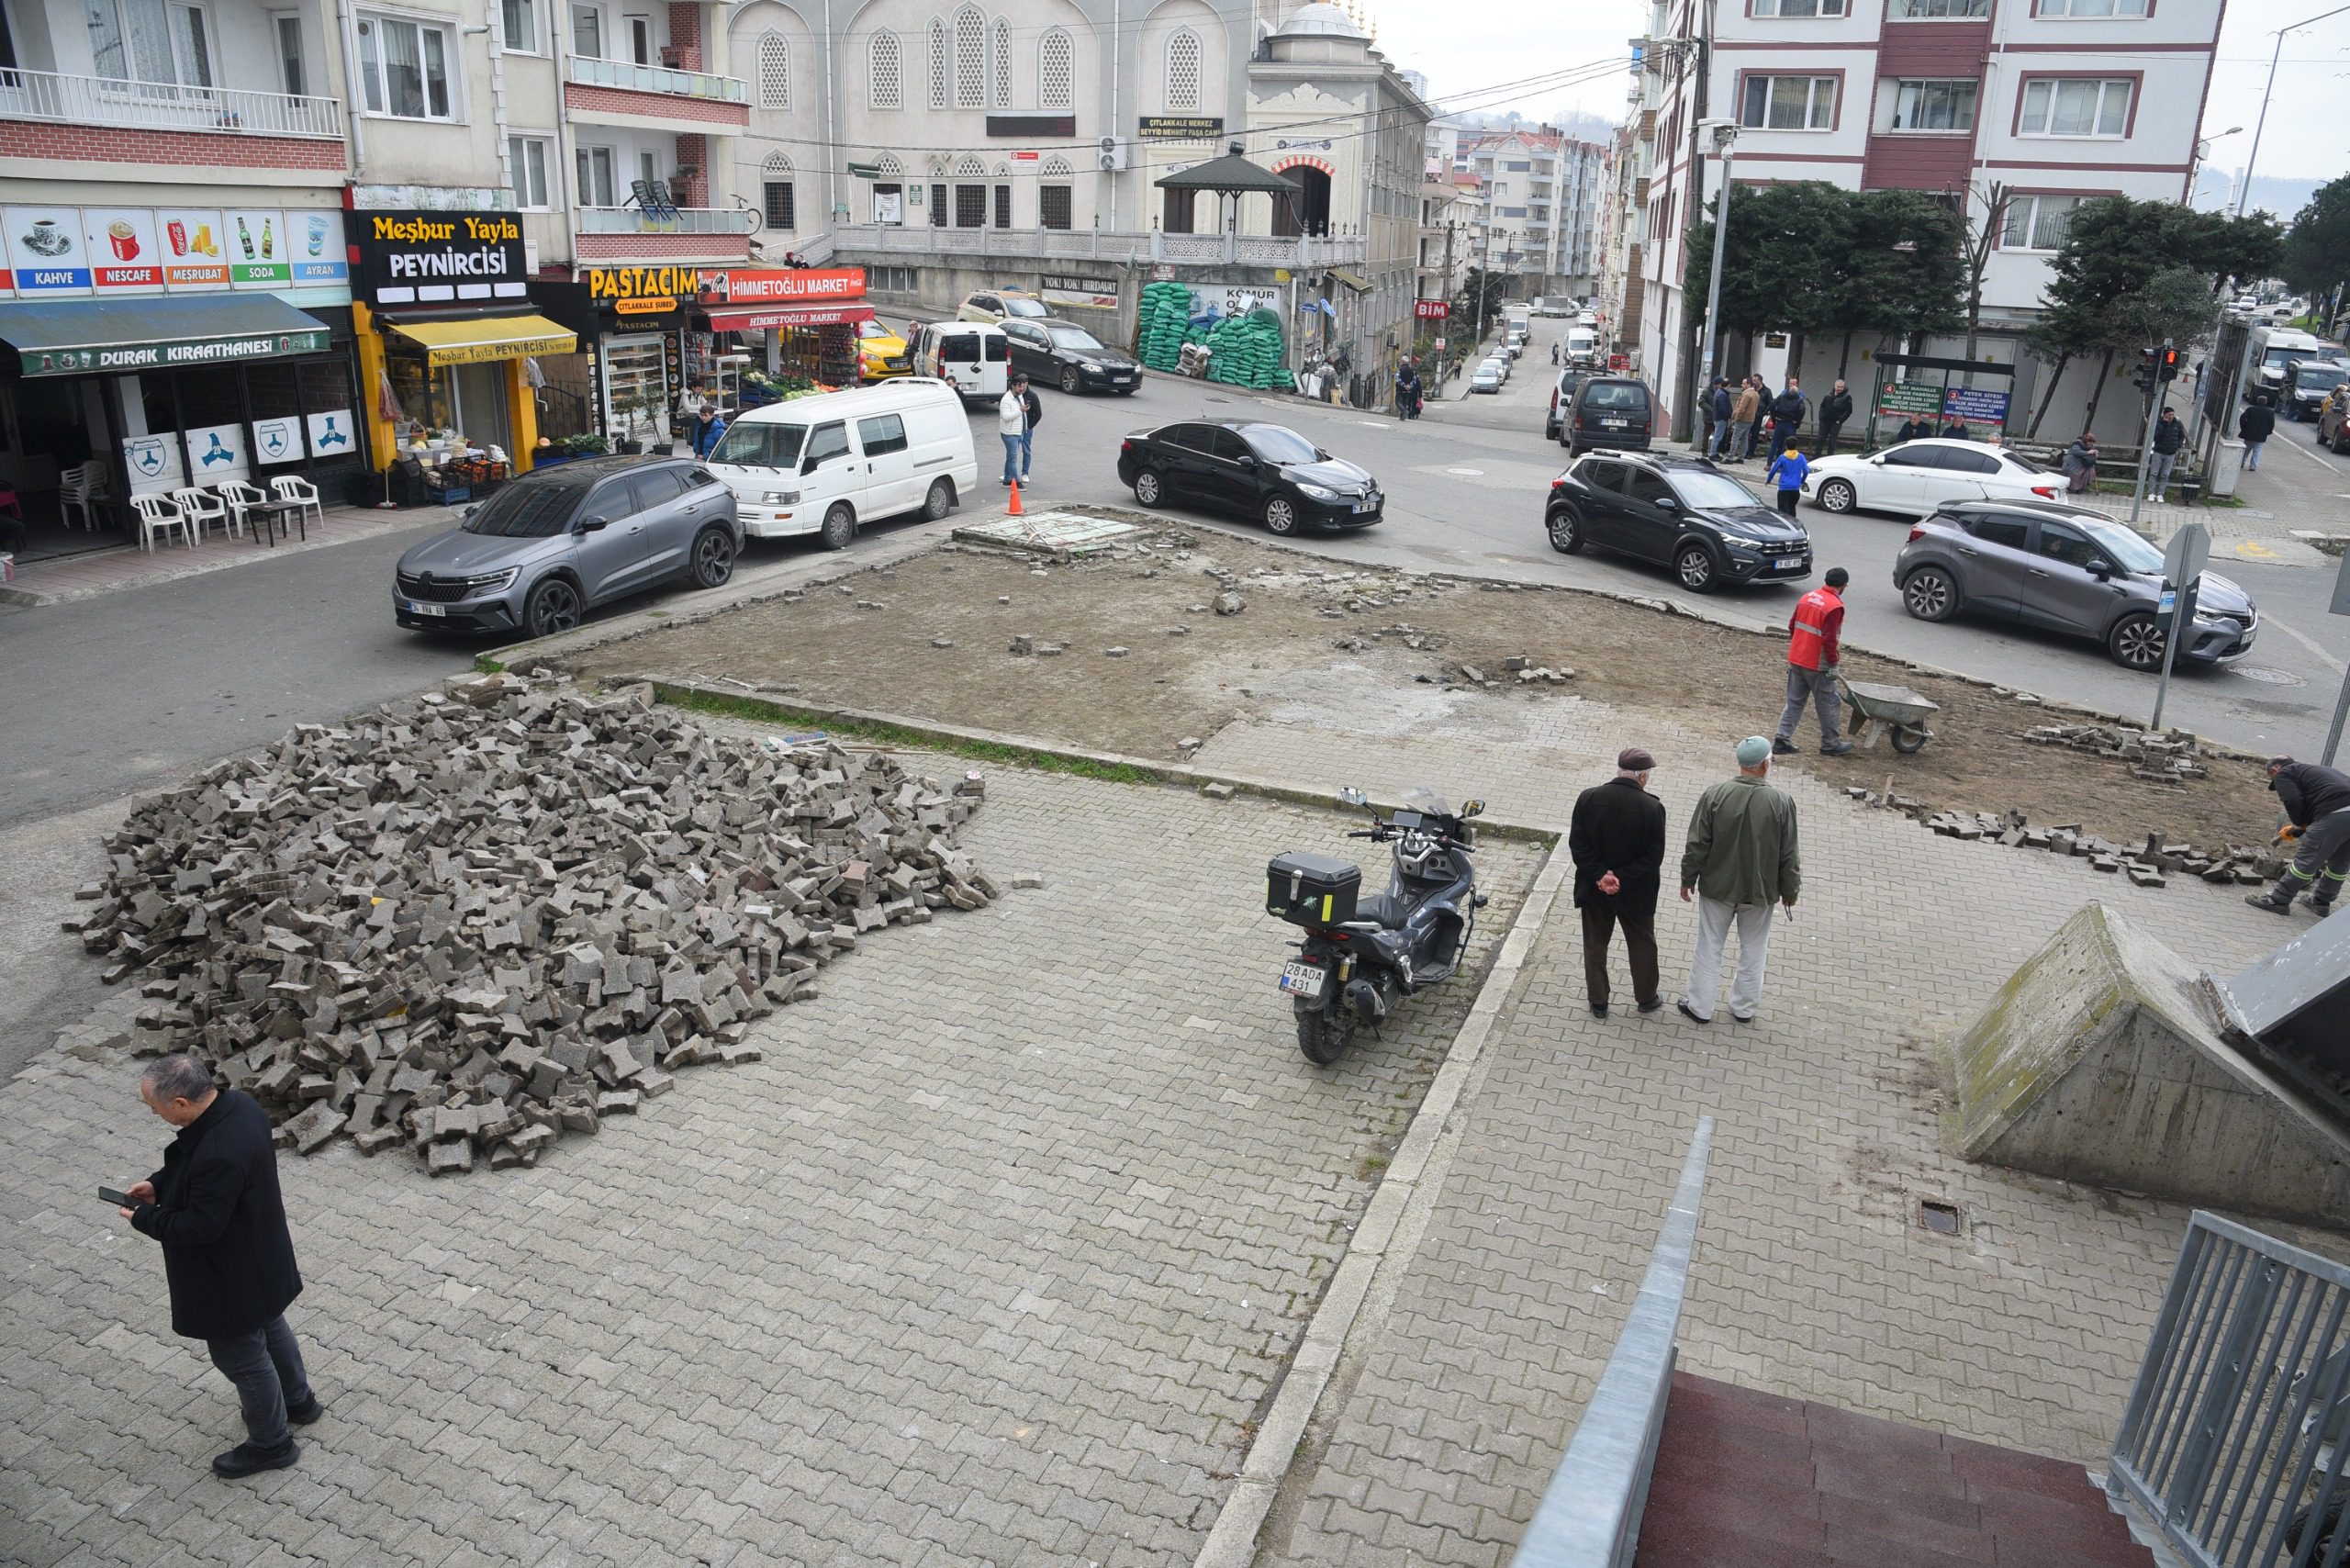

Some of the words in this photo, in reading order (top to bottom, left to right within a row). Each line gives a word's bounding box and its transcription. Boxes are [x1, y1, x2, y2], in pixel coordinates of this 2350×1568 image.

[1149, 119, 1188, 128] ÇITLAKKALE
[373, 216, 455, 243] Meşhur
[464, 217, 519, 244] Yayla
[389, 246, 507, 277] PEYNİRCİSİ
[106, 270, 151, 282] NESCAFE
[173, 269, 222, 284] MEŞRUBAT
[249, 267, 274, 278] SODA
[307, 265, 334, 276] AYRAN
[35, 272, 73, 285] KAHVE
[590, 265, 698, 298] PASTACIM
[732, 277, 805, 297] HİMMETOĞLU
[807, 278, 848, 294] MARKET
[1063, 278, 1080, 290] YOK!
[1082, 279, 1117, 293] HIRDAVAT
[618, 302, 654, 312] ÇITLAKKALE
[655, 301, 675, 310] ŞUBESİ
[1418, 303, 1445, 316] BİM
[620, 321, 659, 330] PASTACIM
[749, 313, 807, 326] HİMMETOĞLU
[810, 313, 842, 322] MARKET
[100, 348, 158, 366] DURAK
[167, 340, 273, 362] KIRAATHANESİ
[433, 351, 465, 362] Meşhur
[469, 347, 493, 359] Yayla
[496, 340, 547, 355] PEYNİRCİSİ
[213, 445, 221, 455] 28
[1287, 964, 1301, 976] 28
[1301, 968, 1322, 982] ADA
[1291, 979, 1309, 991] 431
